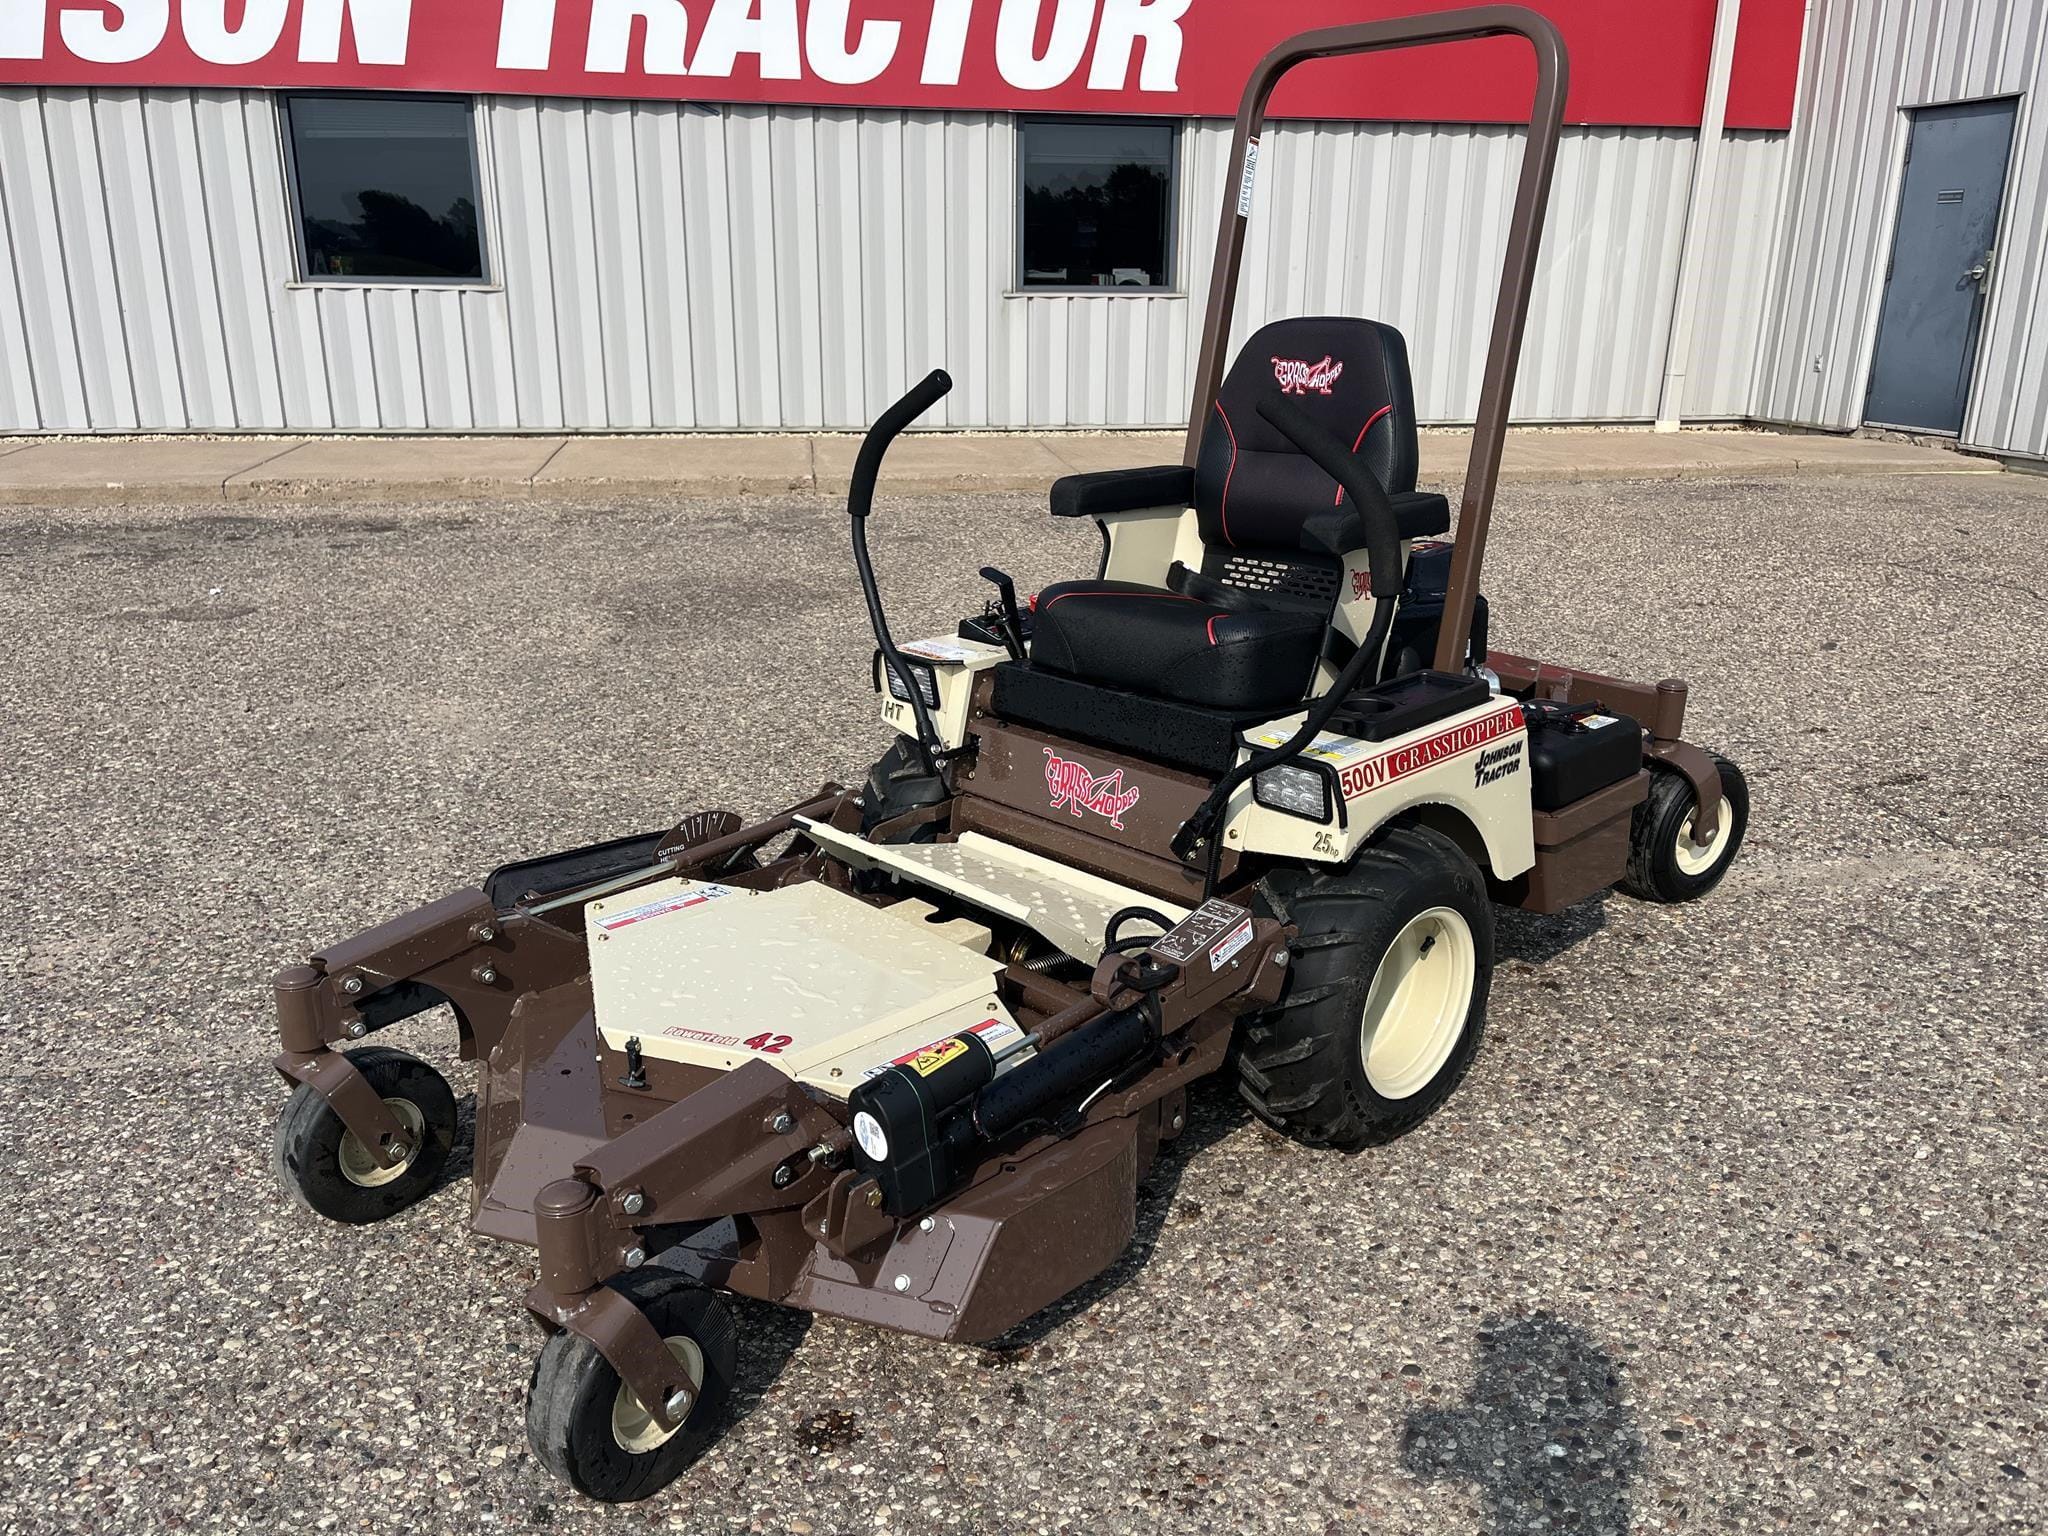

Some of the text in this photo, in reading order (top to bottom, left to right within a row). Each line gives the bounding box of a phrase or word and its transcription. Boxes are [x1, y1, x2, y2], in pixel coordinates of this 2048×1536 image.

[884, 701, 904, 721] HT
[1341, 711, 1515, 796] 500V GRASSHOPPER
[1474, 740, 1524, 771] JOHNSON
[1474, 758, 1521, 789] TRACTOR
[657, 844, 685, 857] CUTTING
[743, 1032, 793, 1054] 42
